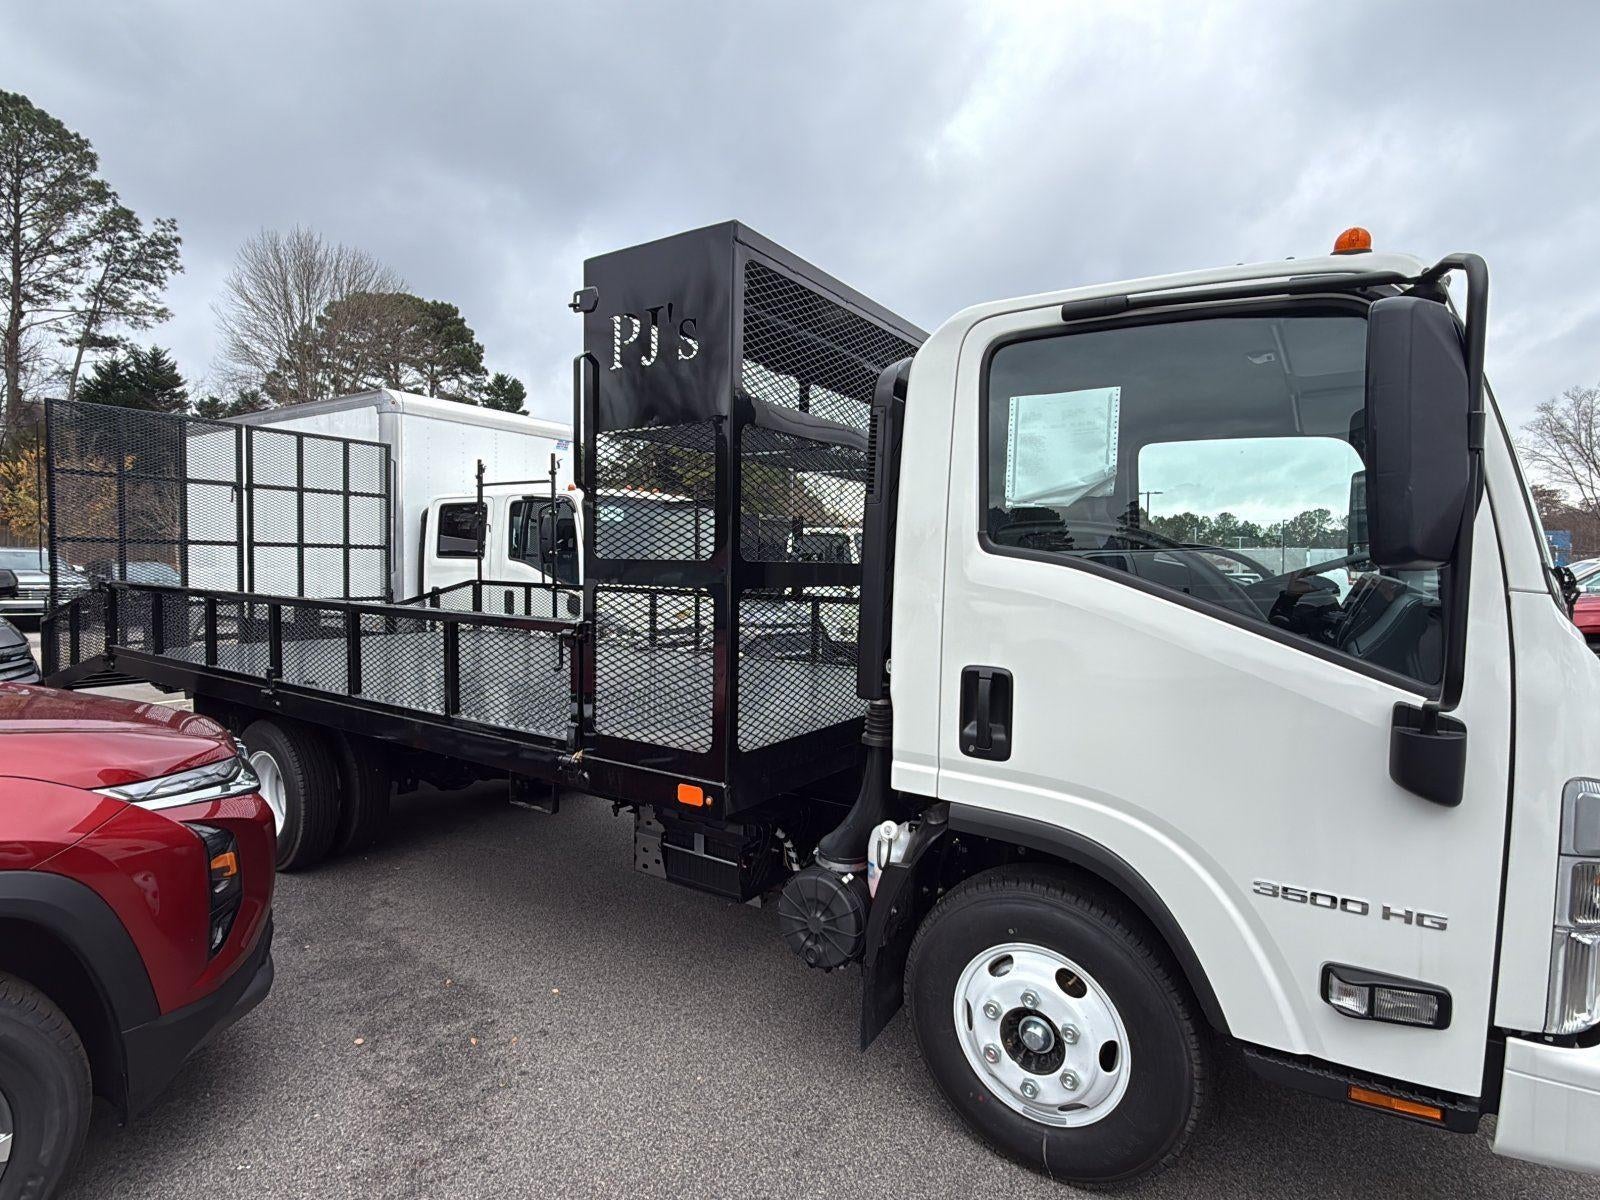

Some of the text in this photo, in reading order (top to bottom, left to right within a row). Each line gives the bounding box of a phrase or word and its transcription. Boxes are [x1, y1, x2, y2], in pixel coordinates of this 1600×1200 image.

[608, 302, 699, 371] PJ's
[1252, 879, 1448, 931] 3500 HG
